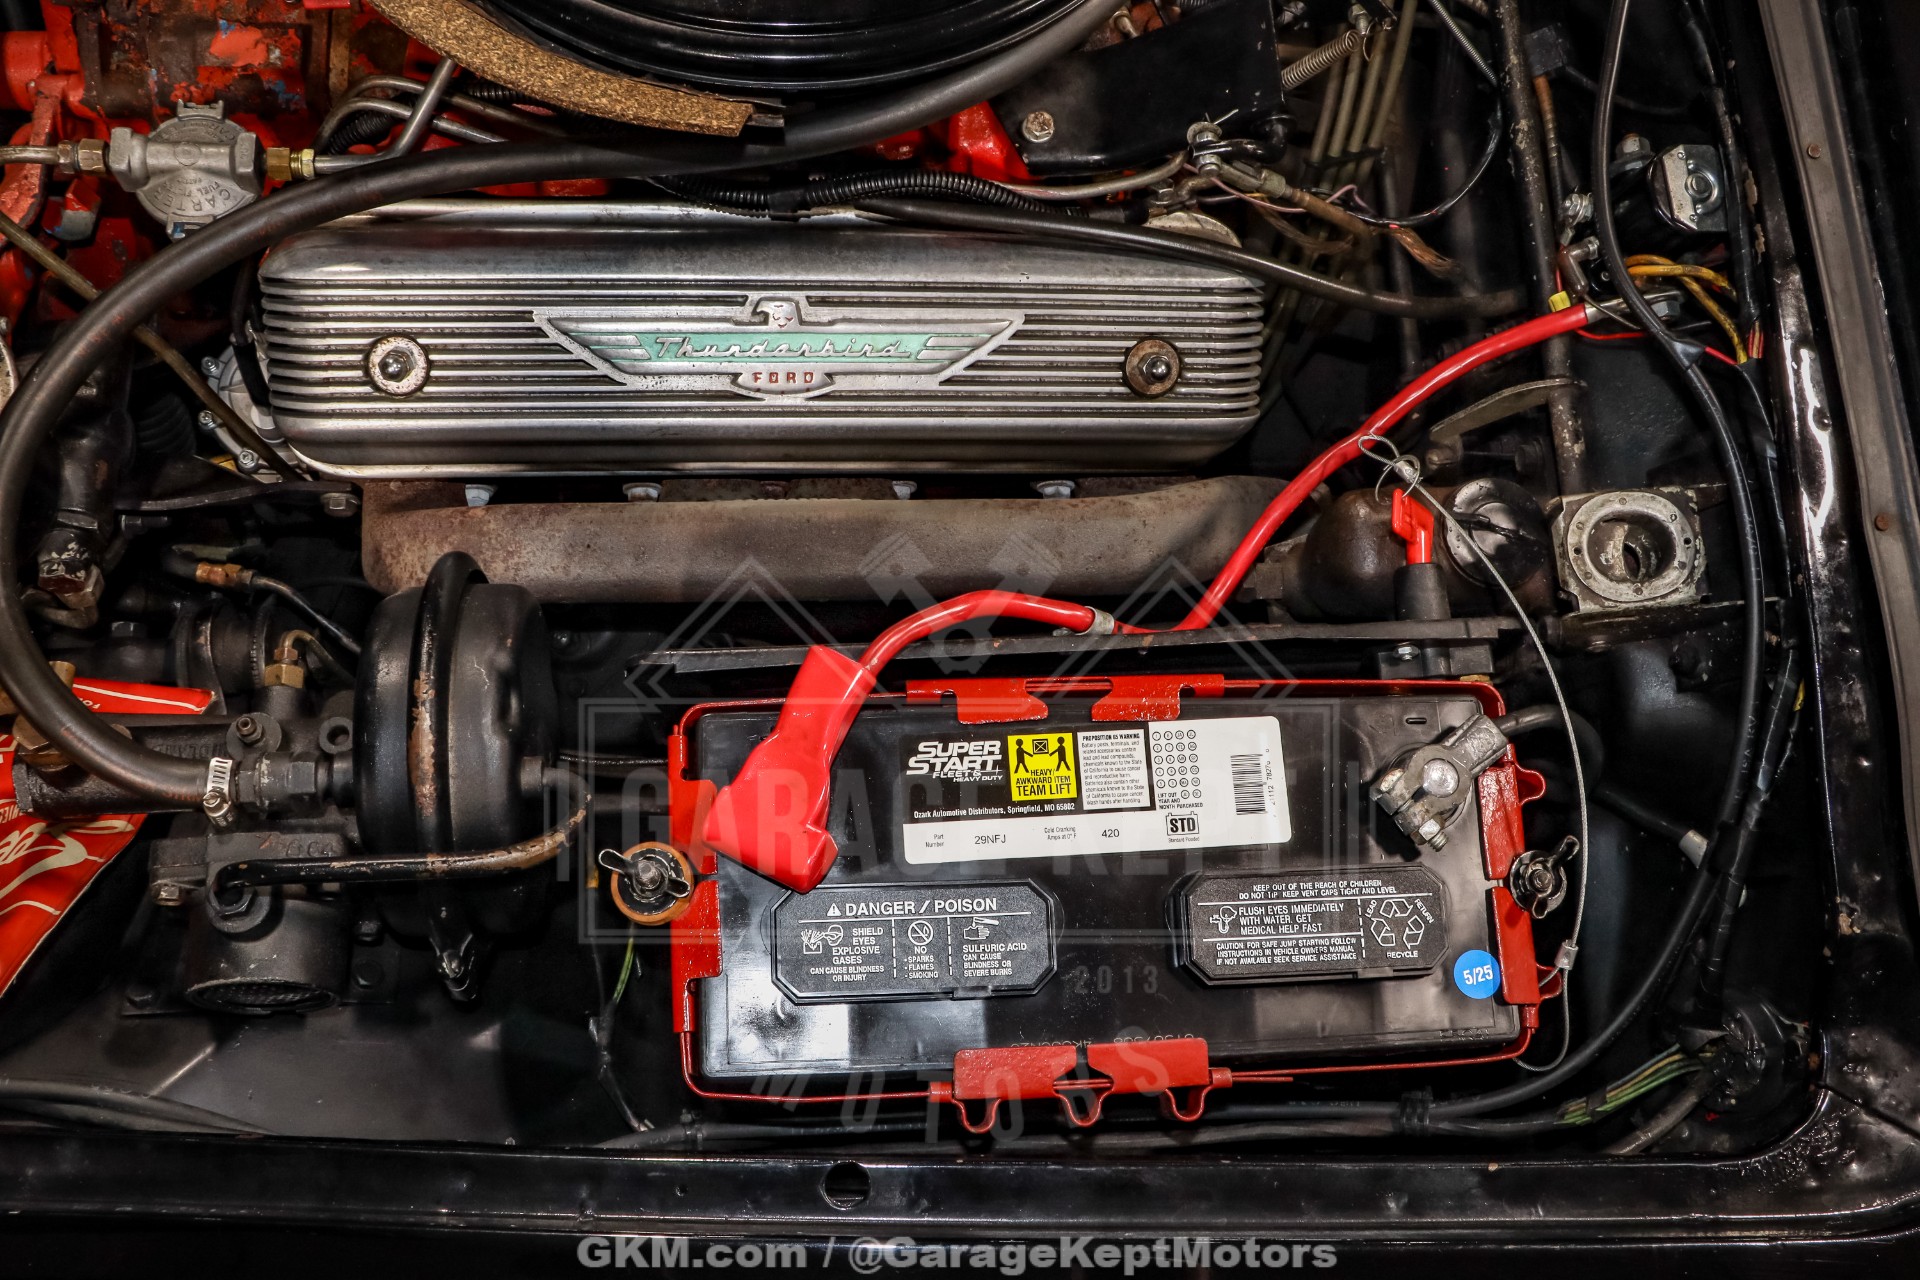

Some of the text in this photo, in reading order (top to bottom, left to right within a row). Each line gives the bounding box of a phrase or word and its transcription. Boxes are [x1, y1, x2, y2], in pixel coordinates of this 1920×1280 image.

[656, 336, 910, 359] Thunderbird
[752, 371, 814, 384] FORD
[917, 741, 1001, 758] SUPER
[906, 755, 1002, 775] START
[932, 769, 981, 778] FLEET &
[1016, 777, 1052, 785] AWKWARD
[1016, 783, 1071, 797] TEAM LIFT
[932, 808, 967, 817] Automotive
[1045, 804, 1055, 812] MO
[1170, 818, 1196, 833] STD
[1101, 828, 1120, 839] 420
[974, 834, 1006, 845] 29NFJ
[1283, 890, 1300, 898] KEEP
[1377, 886, 1397, 894] LEVEL
[846, 898, 997, 916] DANGER / POISON
[1239, 903, 1344, 916] FLUSH EYES IMMEDIATELY
[1365, 900, 1377, 918] LEAD
[1414, 899, 1434, 924] RETURN
[1240, 914, 1312, 925] WITH WATER. GET
[853, 928, 883, 936] SHIELD
[1240, 923, 1322, 935] MEDICAL HELP FAST
[853, 937, 875, 946] EYES
[833, 946, 880, 955] EXPLOSIVE
[914, 946, 927, 954] NO
[963, 943, 1027, 953] SULFURIC ACID
[1218, 949, 1263, 958] INSTRUCTIONS
[1330, 945, 1354, 953] MANUAL
[833, 956, 862, 964] GASES
[963, 953, 977, 961] CAN
[1320, 953, 1357, 961] ASSISTANCE
[964, 961, 999, 969] BLINDNESS
[810, 967, 824, 975] CAN
[964, 968, 1012, 977] SEVERE BURNS
[1463, 965, 1493, 985] 5/25
